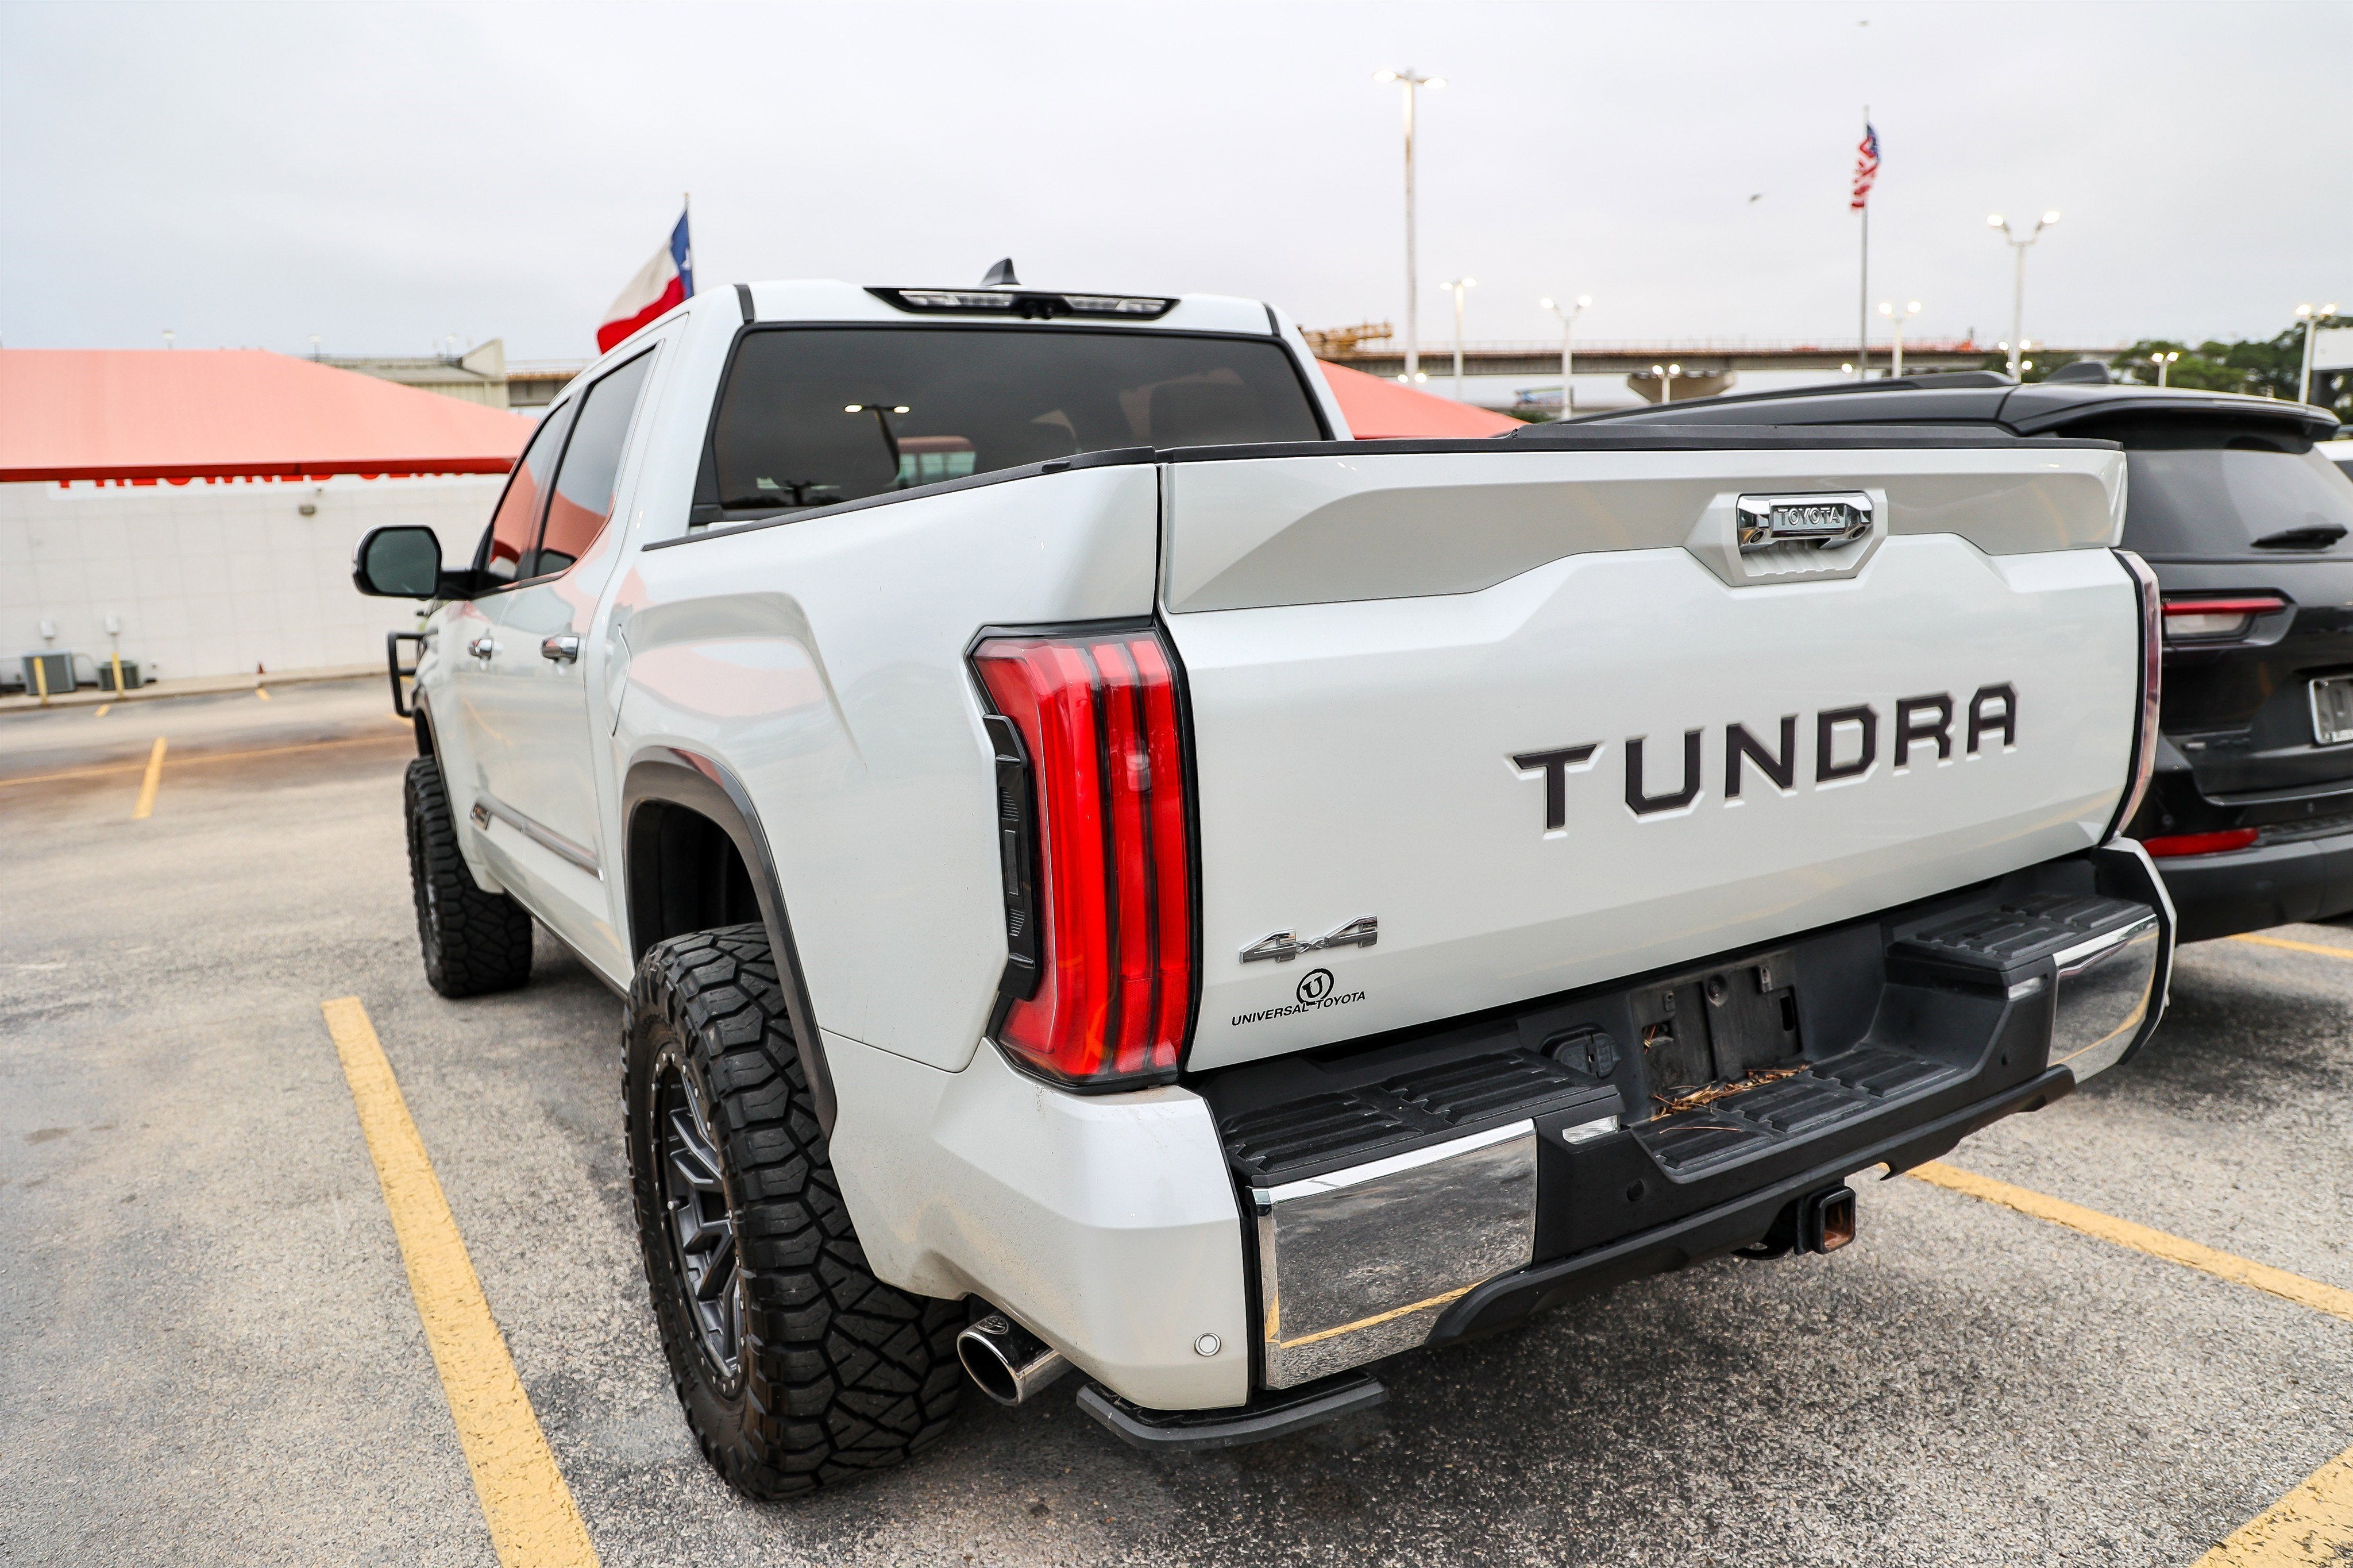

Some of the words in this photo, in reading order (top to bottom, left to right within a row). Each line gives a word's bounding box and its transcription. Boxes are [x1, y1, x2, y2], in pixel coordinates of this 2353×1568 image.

[1778, 507, 1840, 526] TOYOTA
[1510, 682, 2018, 833] TUNDRA
[1232, 1003, 1309, 1026] UNIVERSAL
[1315, 991, 1366, 1010] TOYOTA
